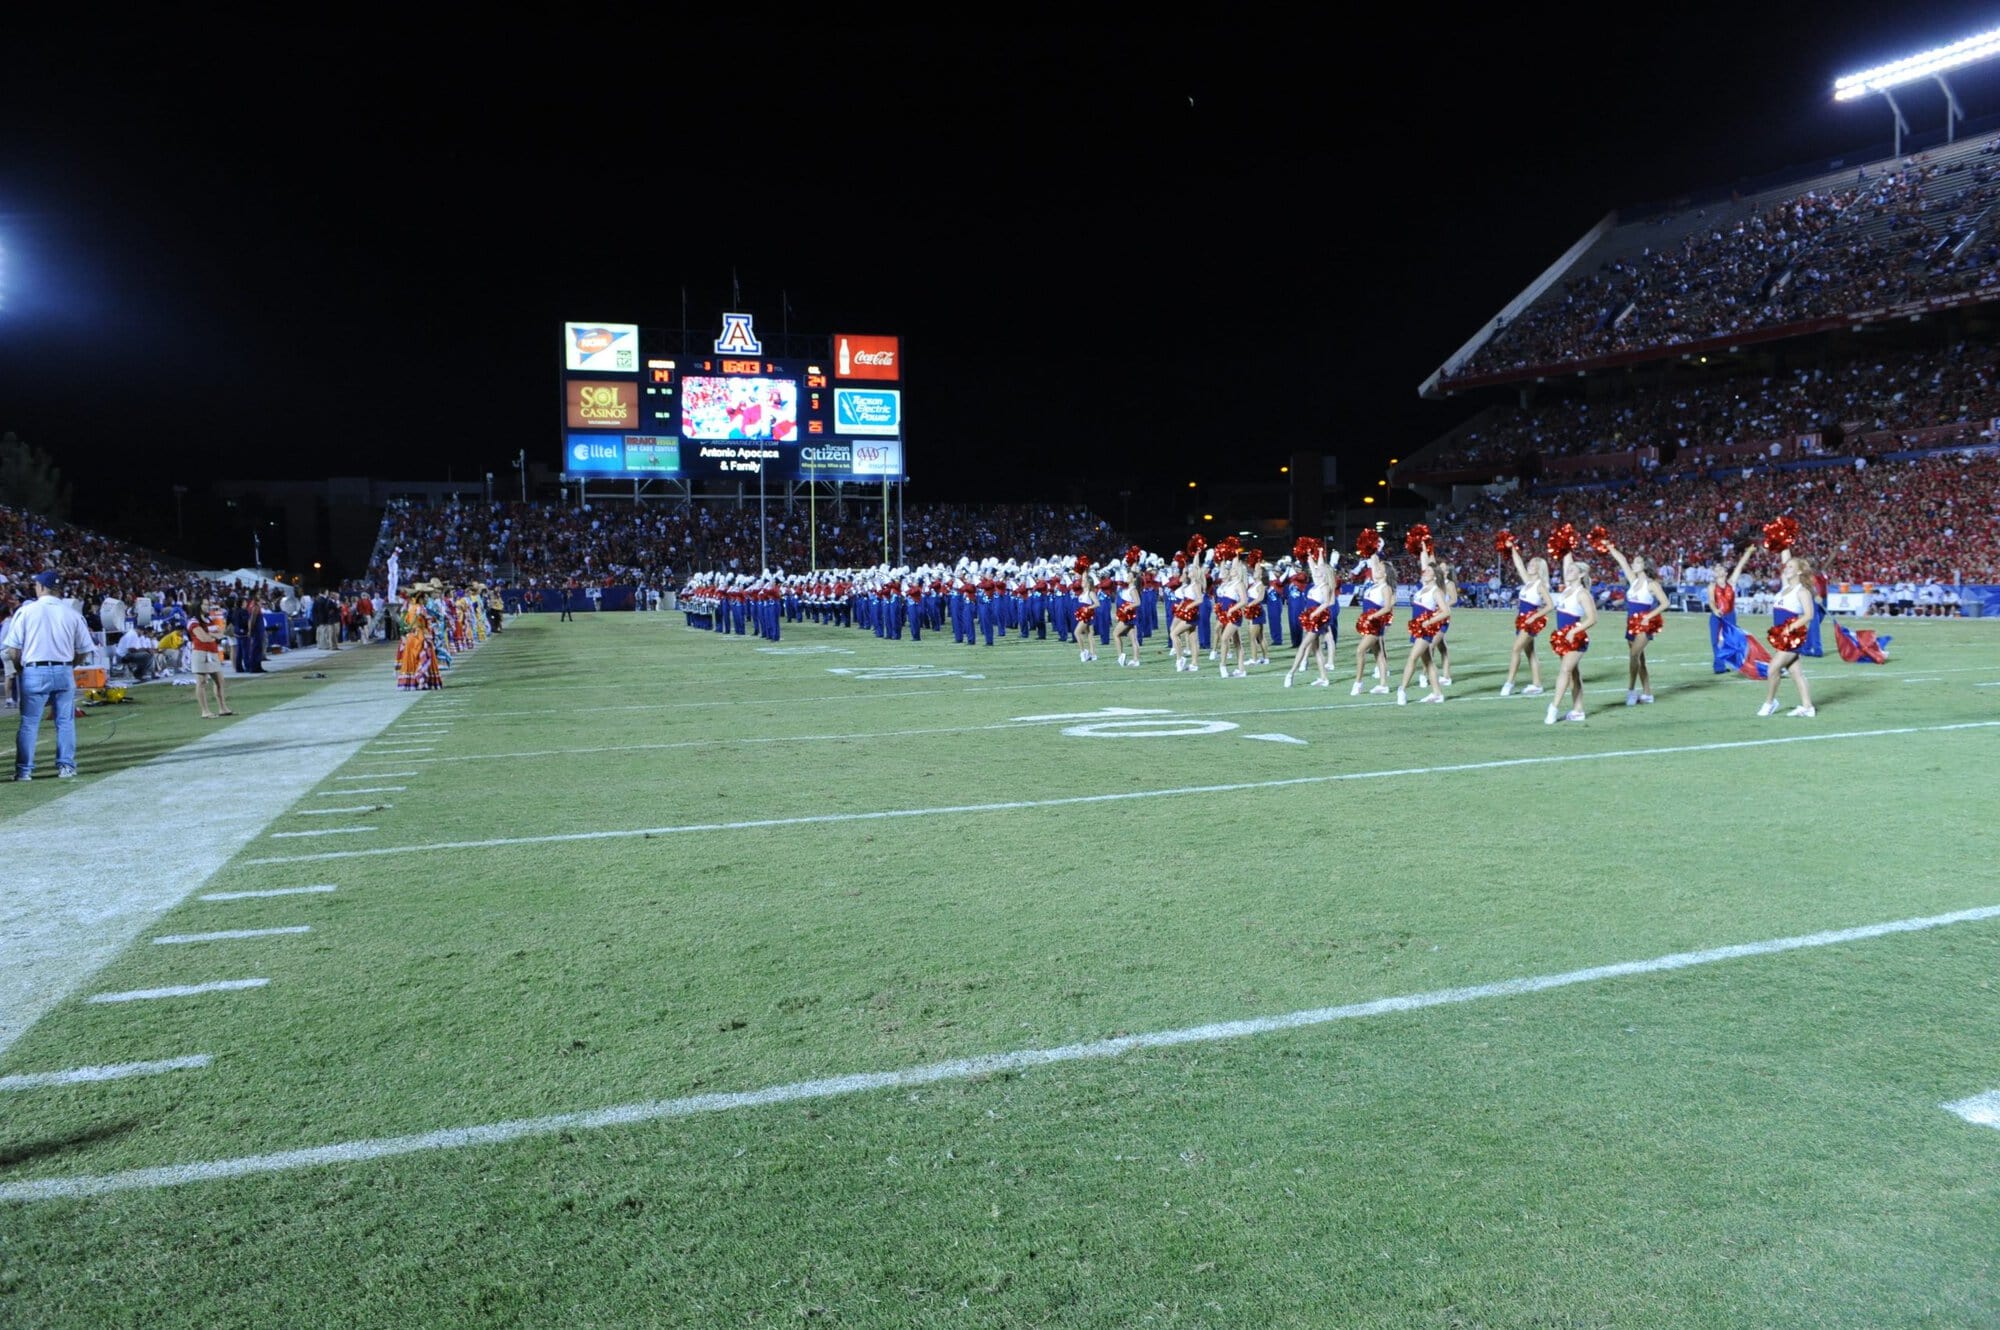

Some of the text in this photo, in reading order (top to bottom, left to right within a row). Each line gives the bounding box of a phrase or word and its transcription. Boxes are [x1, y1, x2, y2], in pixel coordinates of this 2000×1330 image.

[714, 313, 761, 355] A
[854, 350, 894, 366] Coca-Cola
[580, 386, 627, 408] SOL
[853, 395, 884, 406] Tucson
[580, 407, 628, 419] CASINOS
[856, 404, 892, 415] Electric
[860, 412, 893, 422] Power
[700, 446, 737, 458] Antonio
[801, 446, 851, 461] Citizen
[730, 460, 761, 473] Family
